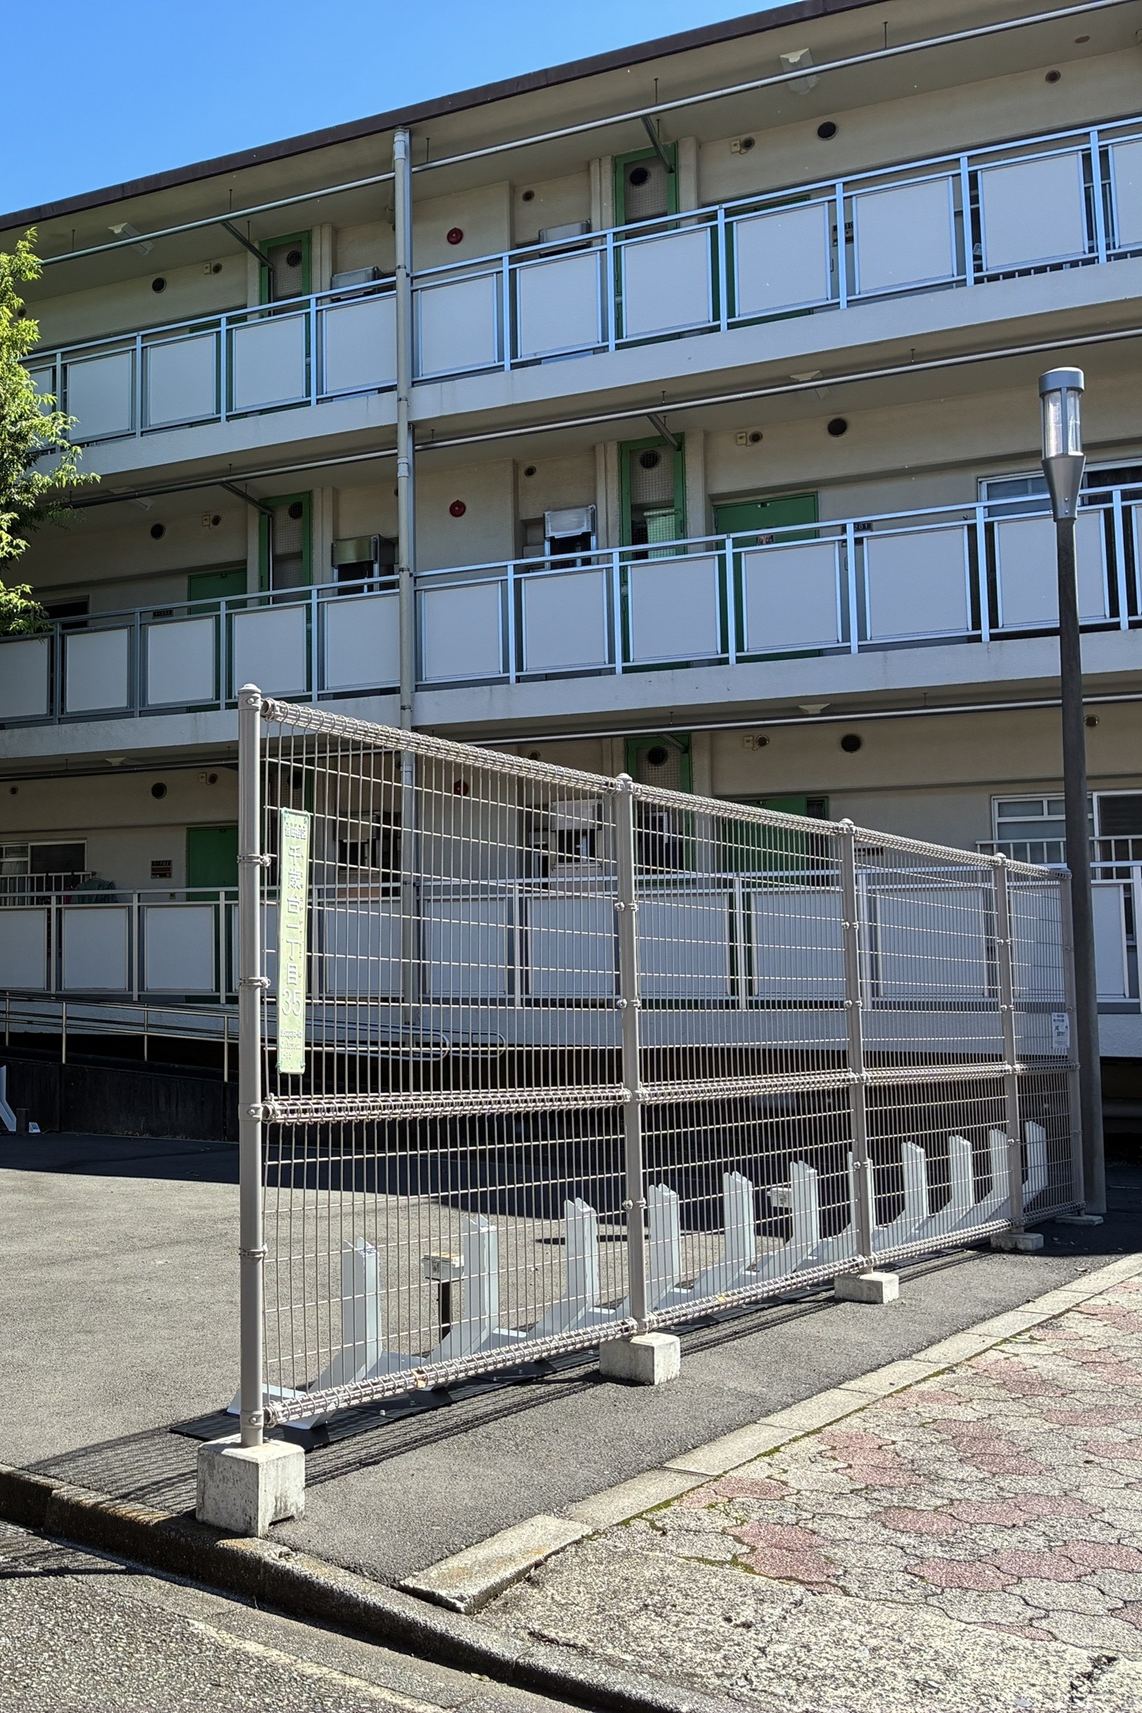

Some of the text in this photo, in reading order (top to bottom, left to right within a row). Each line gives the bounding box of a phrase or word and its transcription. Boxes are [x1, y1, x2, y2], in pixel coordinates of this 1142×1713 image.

[285, 844, 301, 986] 千歳台一丁目
[281, 988, 303, 1017] 35
